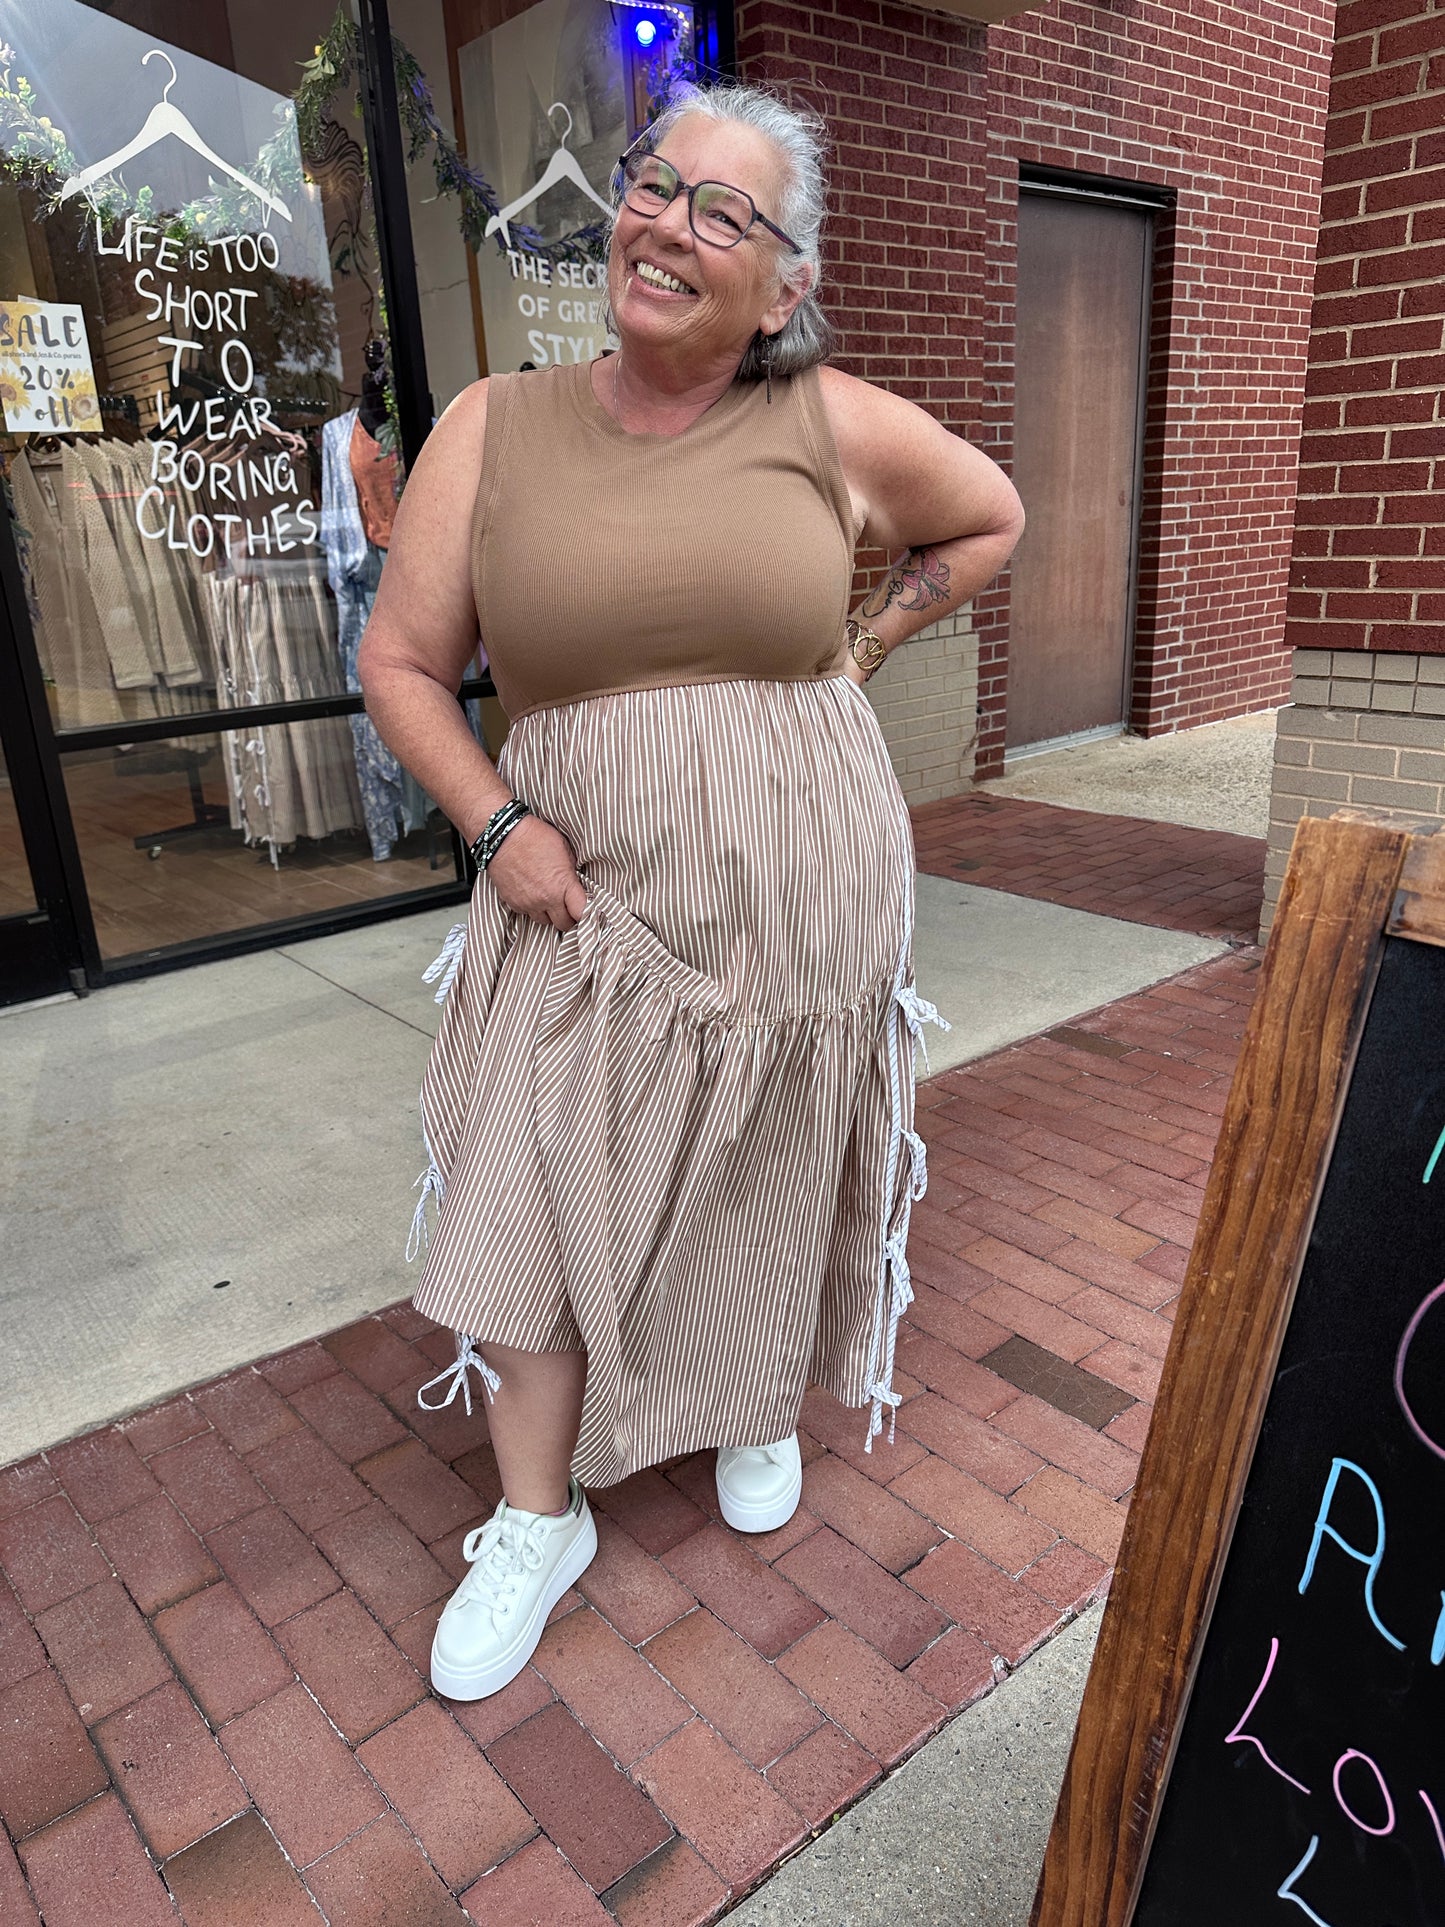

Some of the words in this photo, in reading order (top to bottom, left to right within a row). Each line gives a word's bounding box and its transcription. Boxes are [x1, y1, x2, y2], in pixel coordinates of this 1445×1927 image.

[96, 213, 184, 272] LIFE
[189, 249, 210, 271] IS
[208, 231, 280, 274] TOO
[506, 249, 552, 285] THE
[134, 268, 259, 332] SHORT
[518, 293, 550, 319] OF
[0, 313, 82, 348] SALE
[20, 365, 75, 391] 20%
[157, 336, 254, 394] TO
[157, 389, 281, 441] WEAR
[151, 440, 299, 502] BORING
[136, 485, 318, 559] CLOTHES
